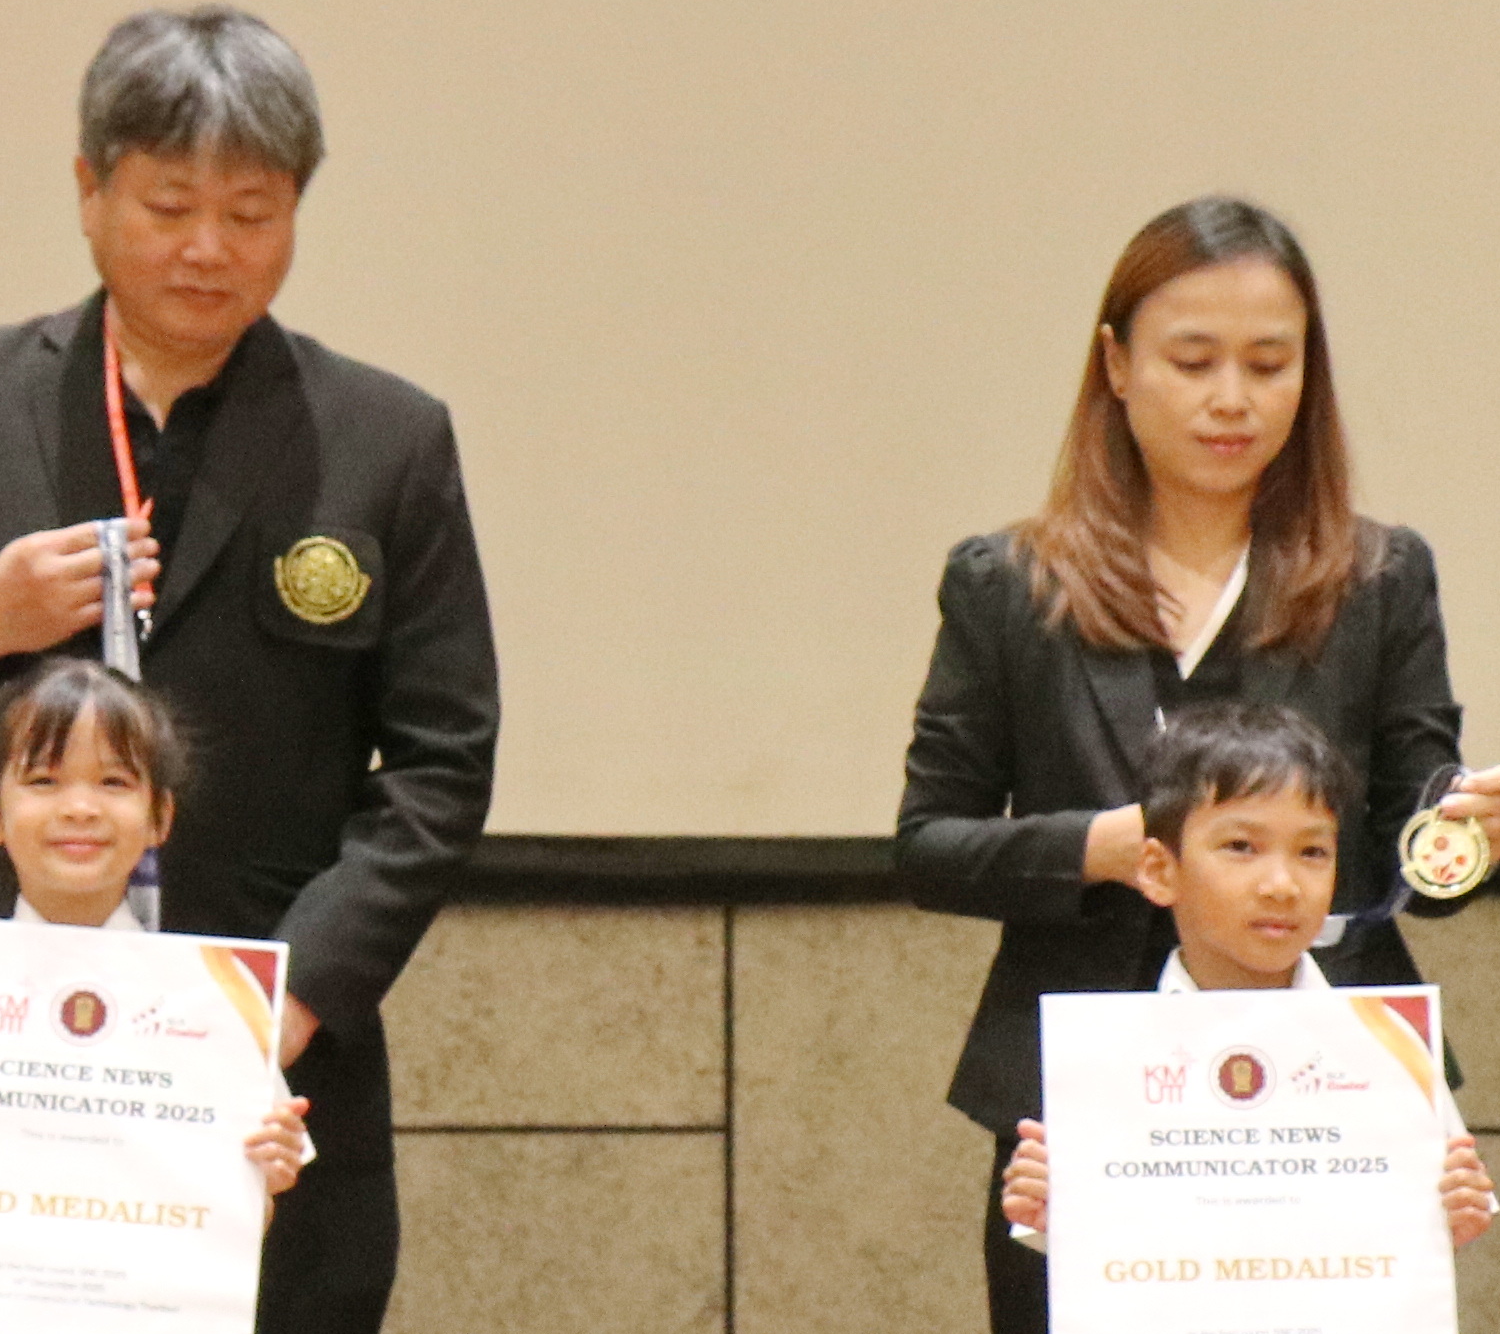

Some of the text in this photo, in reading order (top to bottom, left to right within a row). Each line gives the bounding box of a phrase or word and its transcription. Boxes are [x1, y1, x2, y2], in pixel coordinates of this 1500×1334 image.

[104, 1067, 173, 1087] NEWS
[156, 1103, 215, 1123] 2025
[1149, 1127, 1341, 1146] SCIENCE NEWS
[1104, 1156, 1389, 1177] COMMUNICATOR 2025
[31, 1193, 210, 1229] MEDALIST
[1103, 1255, 1394, 1282] GOLD MEDALIST
